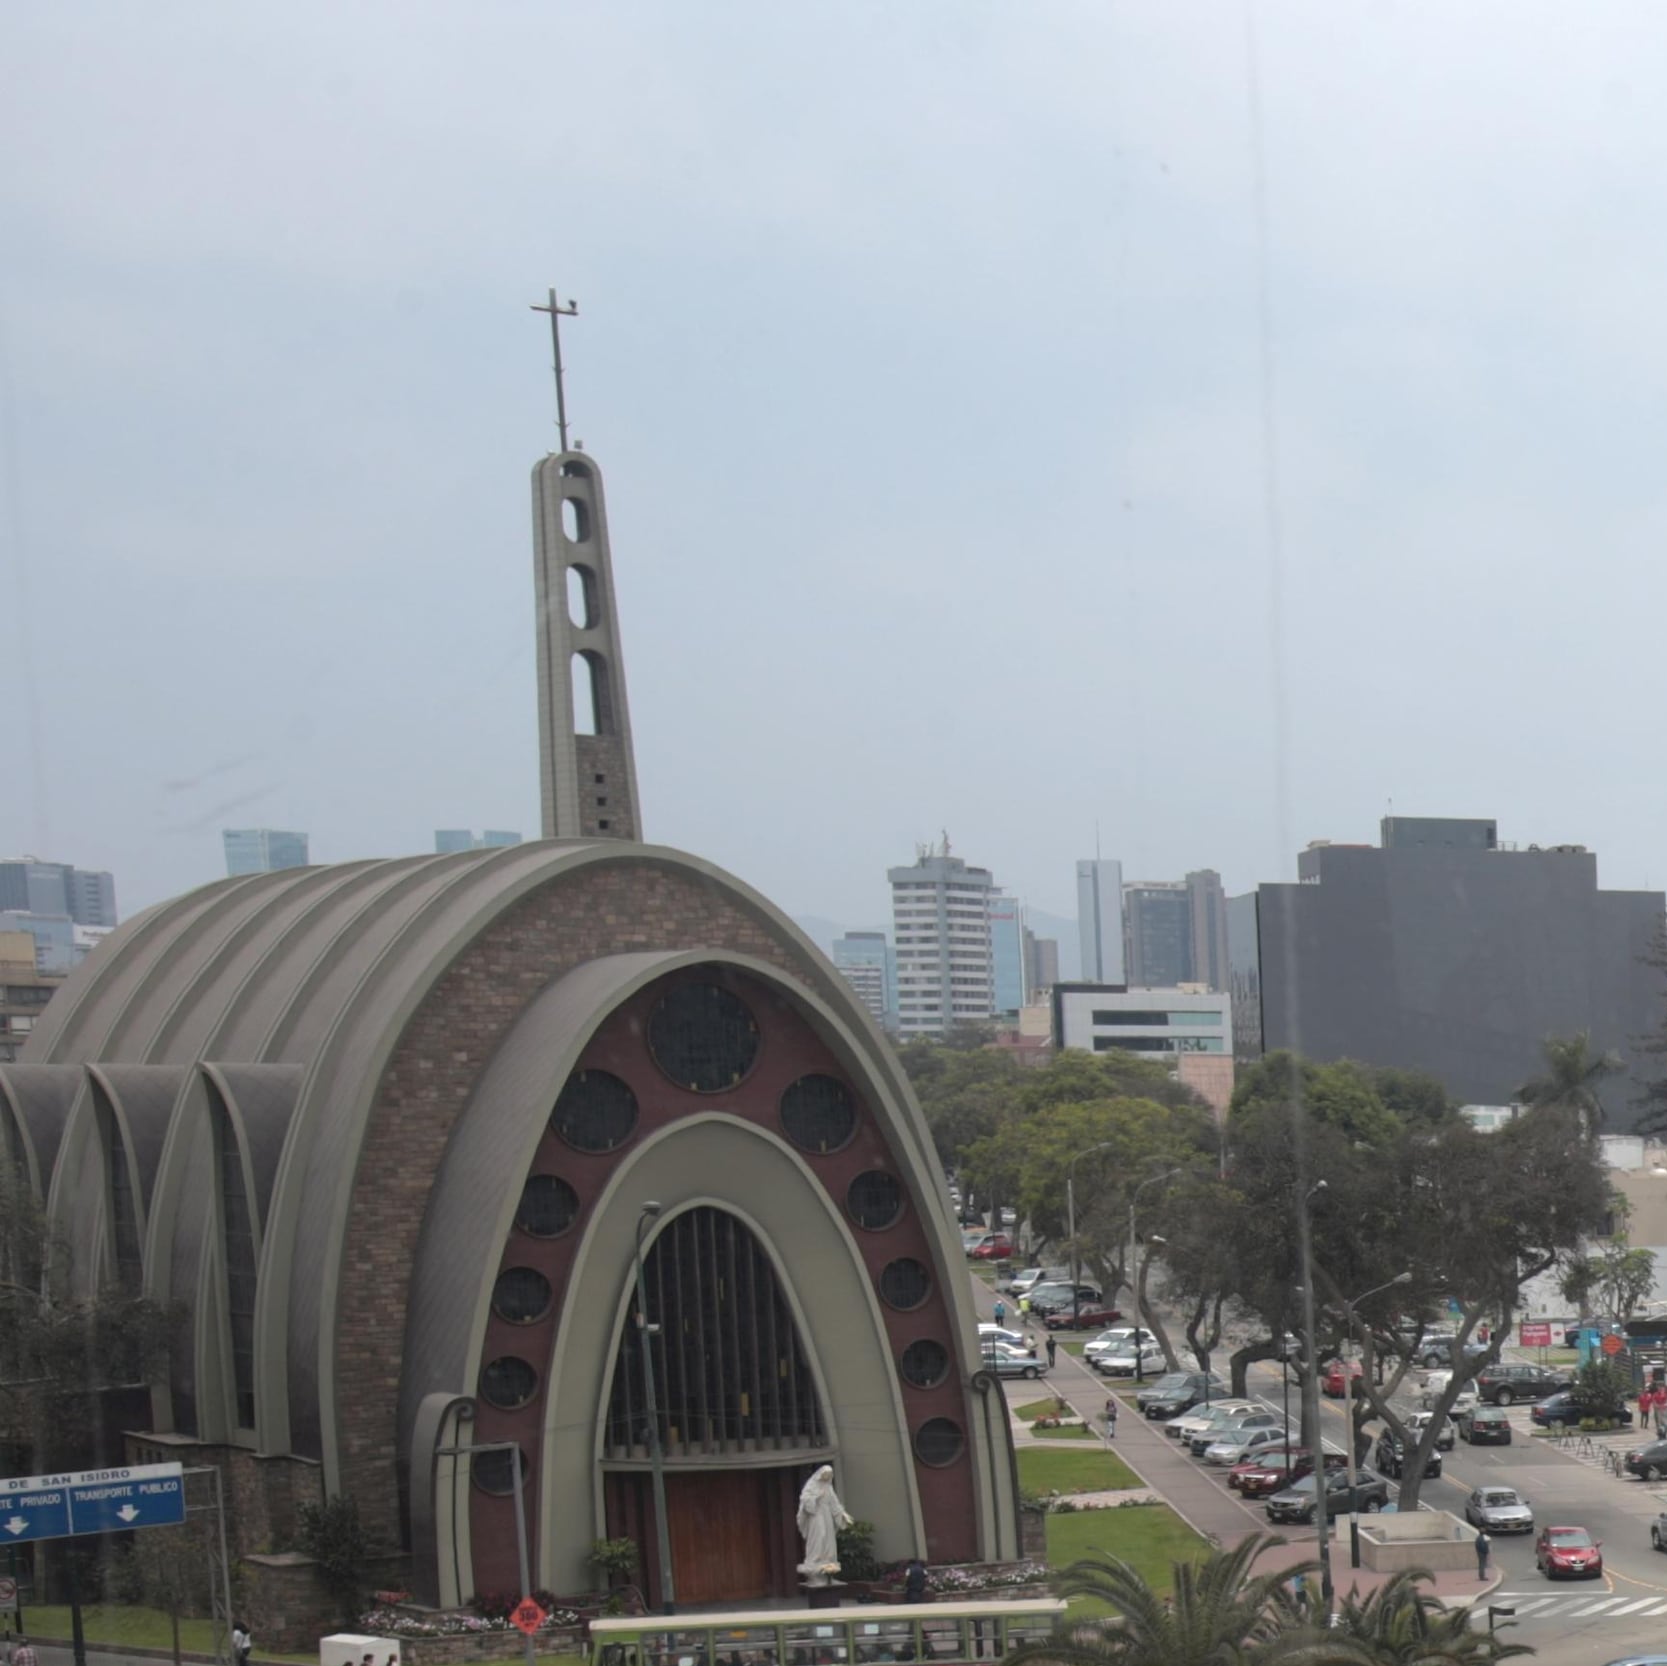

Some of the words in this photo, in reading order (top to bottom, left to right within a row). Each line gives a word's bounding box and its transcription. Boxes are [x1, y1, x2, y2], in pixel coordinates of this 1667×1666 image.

[8, 1479, 29, 1489] DE
[42, 1476, 72, 1487] SAN
[81, 1469, 130, 1483] ISIDRO
[20, 1493, 61, 1508] PRIVADO
[75, 1485, 133, 1502] TRANSPORTE
